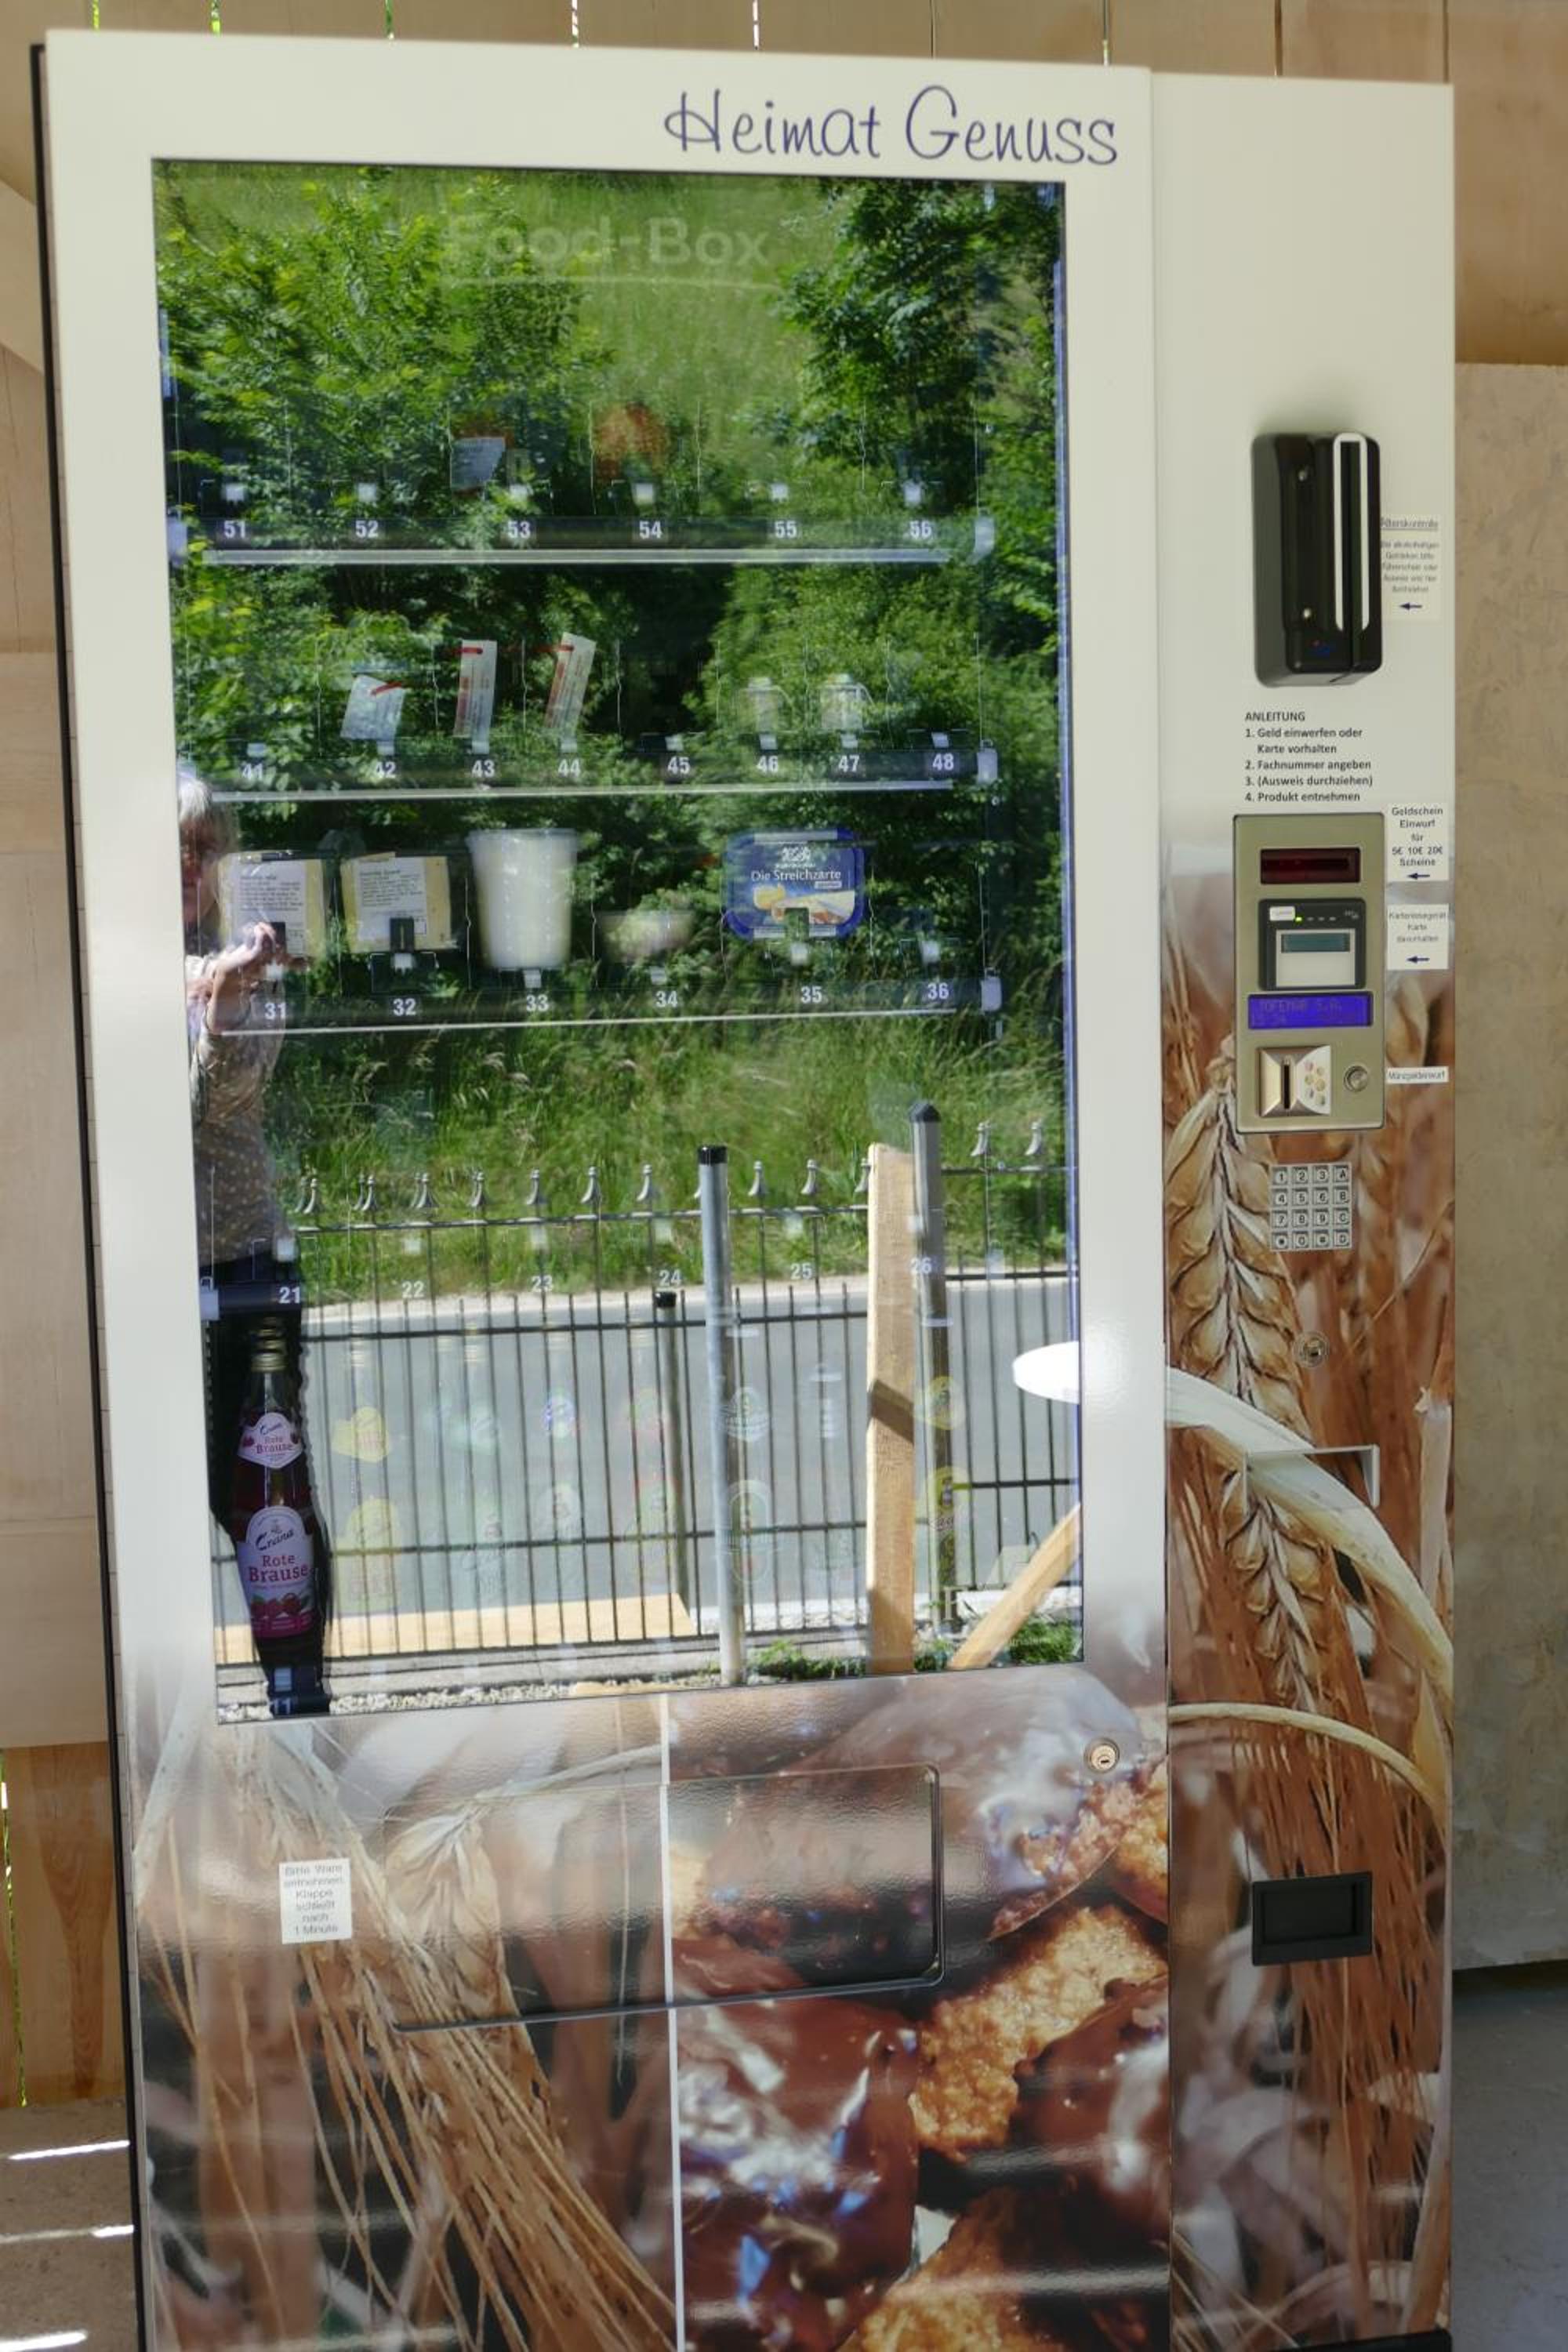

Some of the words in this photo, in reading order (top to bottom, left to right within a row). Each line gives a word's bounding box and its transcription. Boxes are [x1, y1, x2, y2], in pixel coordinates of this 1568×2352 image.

[663, 88, 881, 158] Heimat
[905, 84, 1118, 165] Genuss
[224, 520, 246, 539] 51
[355, 521, 379, 539] 52
[507, 521, 531, 539] 53
[639, 520, 662, 539] 54
[774, 520, 798, 539] 55
[909, 520, 932, 539] 56
[1245, 711, 1305, 722] ANLEITUNG
[1246, 728, 1254, 738] 1.
[1258, 728, 1281, 738] Geld
[1283, 727, 1336, 738] einwerfen
[1339, 728, 1363, 738] oder
[1258, 744, 1284, 753] Karte
[1287, 744, 1337, 753] vorhalten
[374, 760, 397, 779] 42
[472, 760, 495, 778] 43
[557, 759, 581, 776] 44
[666, 757, 691, 775] 45
[757, 755, 779, 773] 46
[837, 754, 860, 772] 47
[932, 753, 954, 771] 48
[1245, 760, 1254, 770] 2.
[1258, 760, 1325, 770] Fachnummer
[1328, 760, 1371, 772] angeben
[1245, 775, 1254, 786] 3.
[1258, 775, 1304, 787] (Ausweis
[1307, 775, 1374, 787] durchziehen)
[1245, 792, 1254, 802] 4.
[1258, 791, 1299, 802] Produkt
[1301, 791, 1360, 802] entnehmen
[1392, 806, 1443, 816] Geldschein
[1399, 818, 1436, 829] Einwurf
[1411, 832, 1424, 841] für
[1392, 846, 1403, 855] 5€
[1408, 846, 1423, 855] 10€
[1427, 846, 1443, 855] 20€
[1399, 858, 1436, 866] Scheine
[750, 869, 771, 881] Die
[774, 868, 841, 881] Streichzarte
[264, 1002, 287, 1020] 31
[393, 998, 417, 1017] 32
[525, 994, 550, 1013] 33
[655, 990, 678, 1009] 34
[800, 985, 823, 1004] 35
[927, 982, 950, 1001] 36
[278, 1287, 302, 1305] 21
[401, 1280, 425, 1298] 22
[531, 1275, 554, 1293] 23
[659, 1269, 684, 1287] 24
[789, 1262, 814, 1280] 25
[910, 1256, 933, 1275] 26
[256, 1443, 295, 1454] Brause
[256, 1529, 295, 1552] Crana
[262, 1555, 296, 1567] Rote
[249, 1564, 310, 1582] Brause
